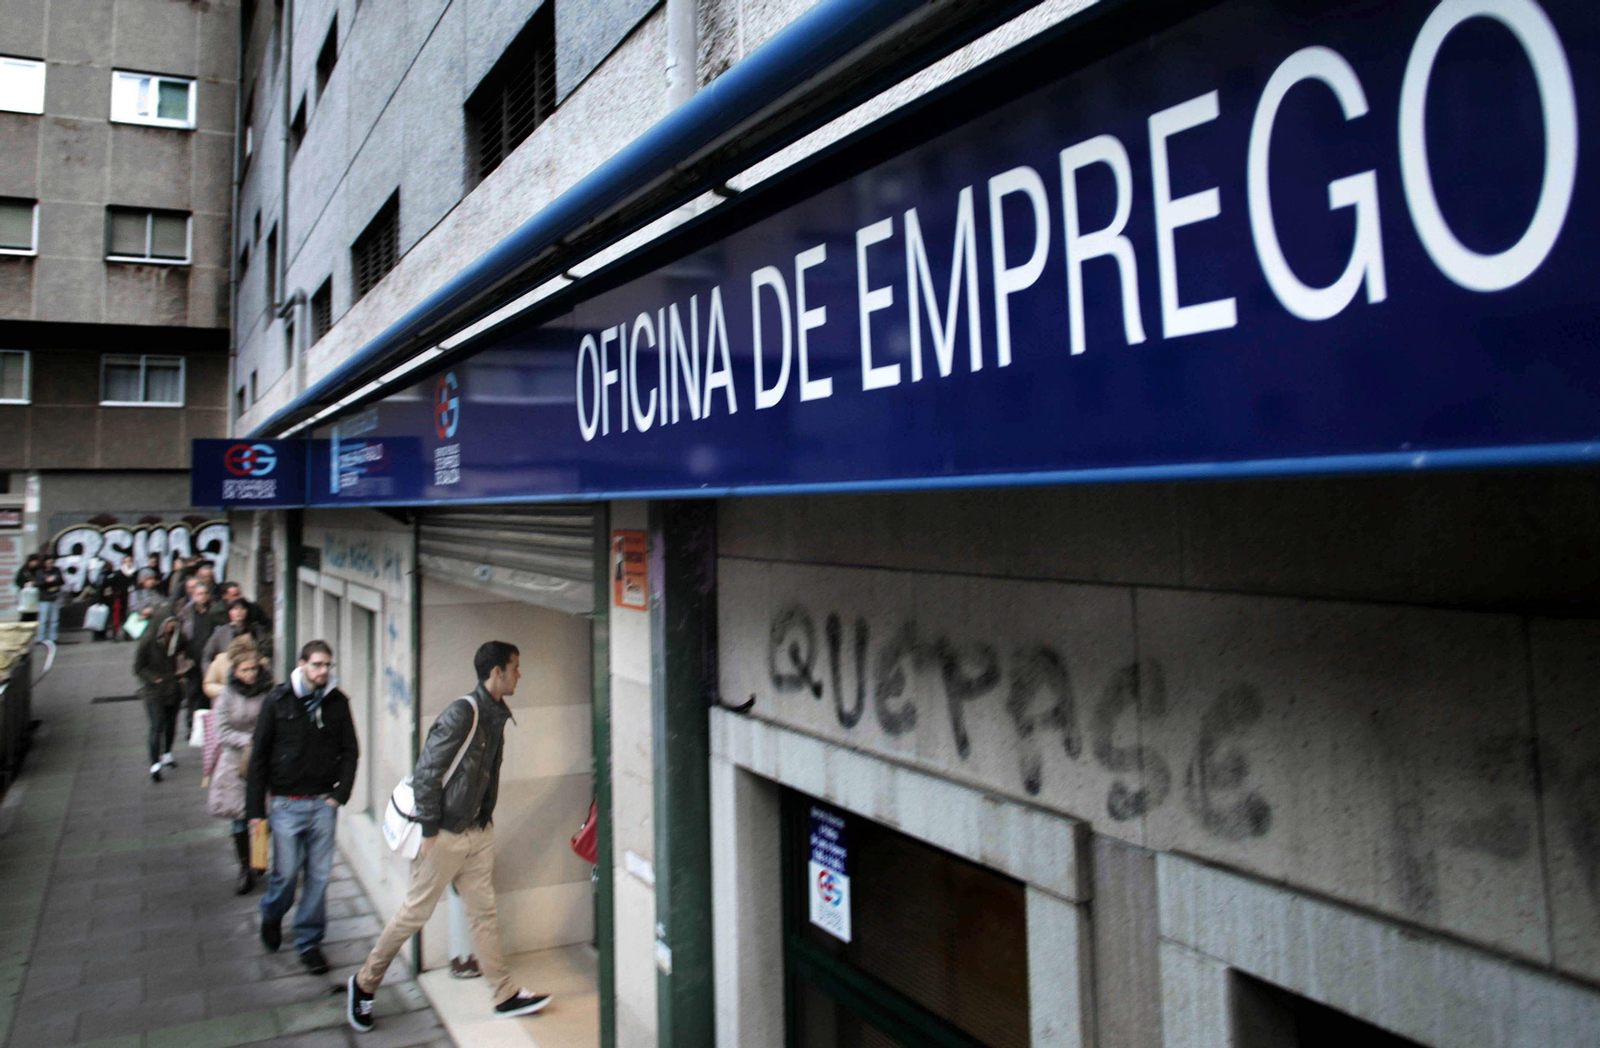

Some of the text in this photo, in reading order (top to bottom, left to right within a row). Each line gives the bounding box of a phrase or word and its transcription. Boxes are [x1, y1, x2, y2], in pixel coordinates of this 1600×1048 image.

[576, 0, 1579, 443] OFICINA DE EMPREGO
